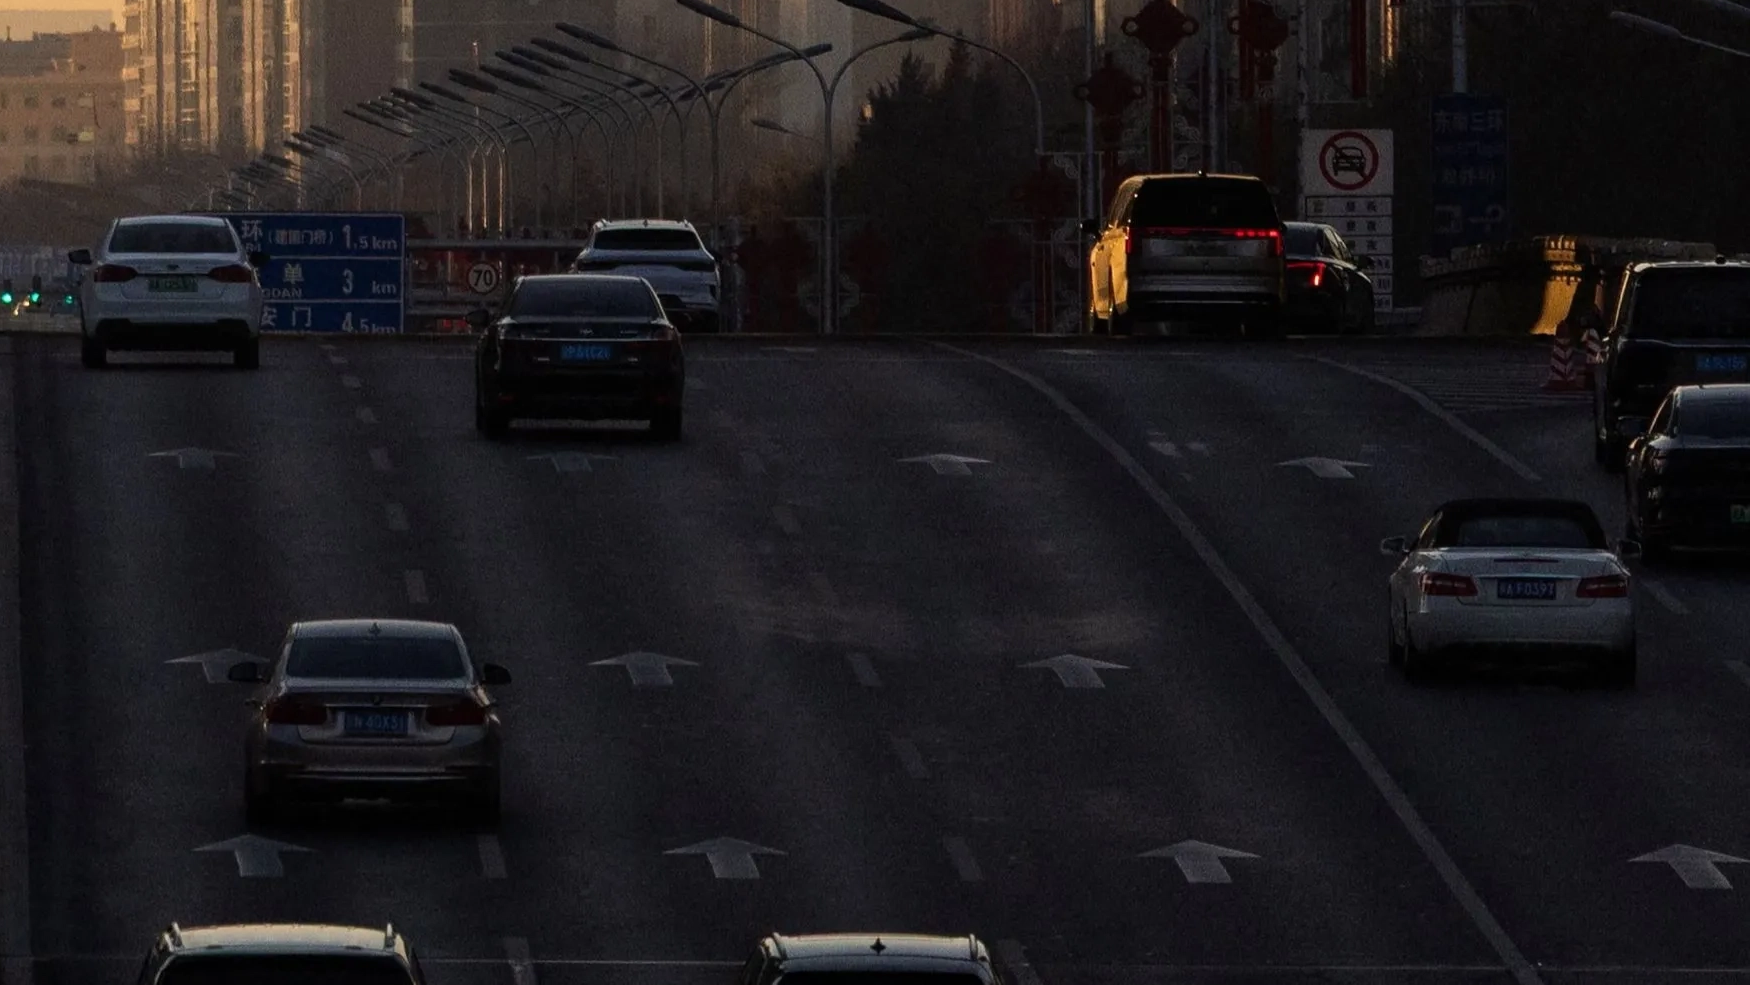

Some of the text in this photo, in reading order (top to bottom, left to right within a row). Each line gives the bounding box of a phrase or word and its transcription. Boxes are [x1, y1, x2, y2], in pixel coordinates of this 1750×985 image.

[241, 219, 263, 241] 环
[372, 234, 398, 250] km
[342, 268, 354, 295] 3
[371, 279, 396, 295] km
[473, 269, 493, 286] 70
[262, 287, 303, 298] GDAN
[261, 305, 312, 328] 安门
